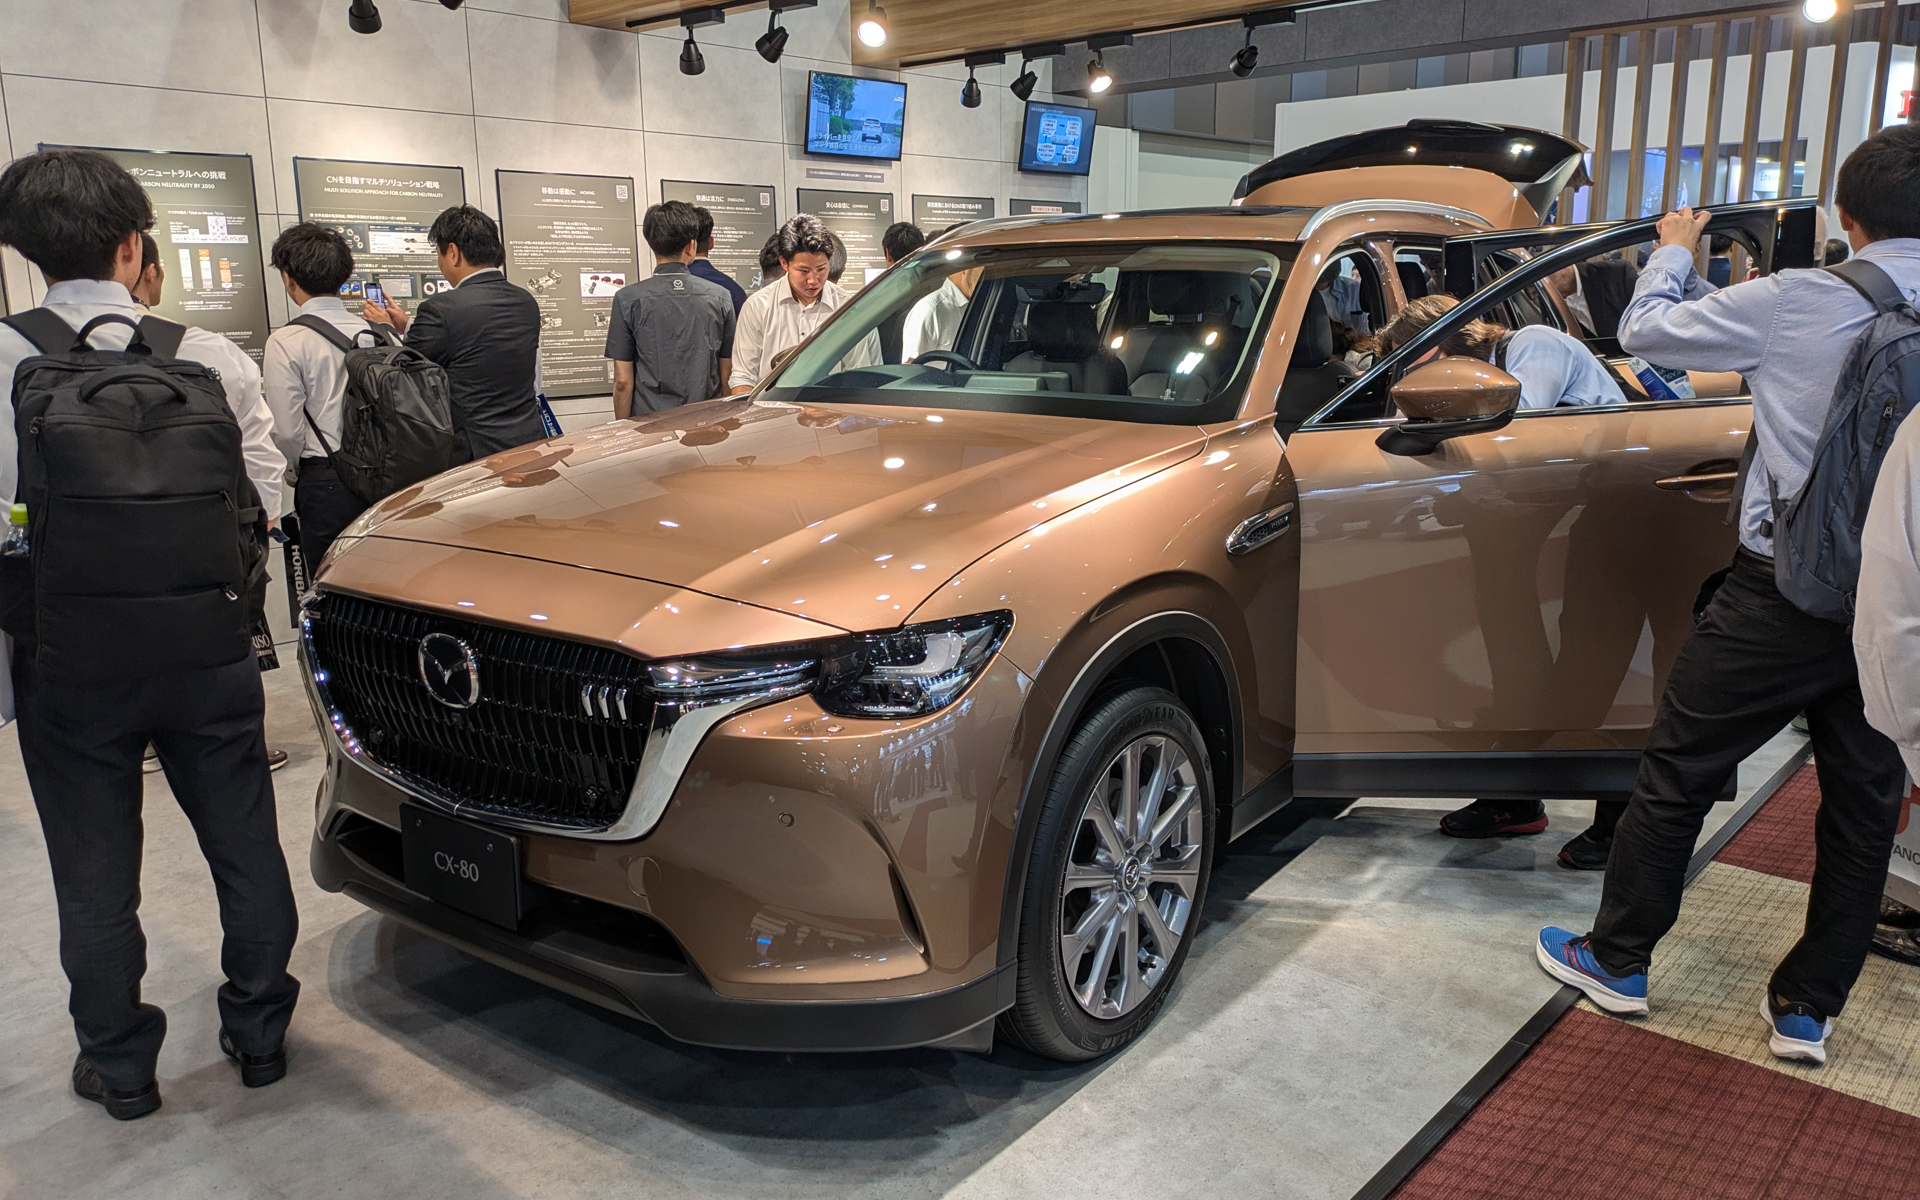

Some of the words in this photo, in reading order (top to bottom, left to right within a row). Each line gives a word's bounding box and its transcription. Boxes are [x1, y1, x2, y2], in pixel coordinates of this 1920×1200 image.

[326, 175, 440, 189] CNを目指すマルチソリューション戦略
[541, 186, 576, 196] 移動は感動に
[1892, 843, 1920, 866] ANC
[434, 851, 480, 883] CX-80
